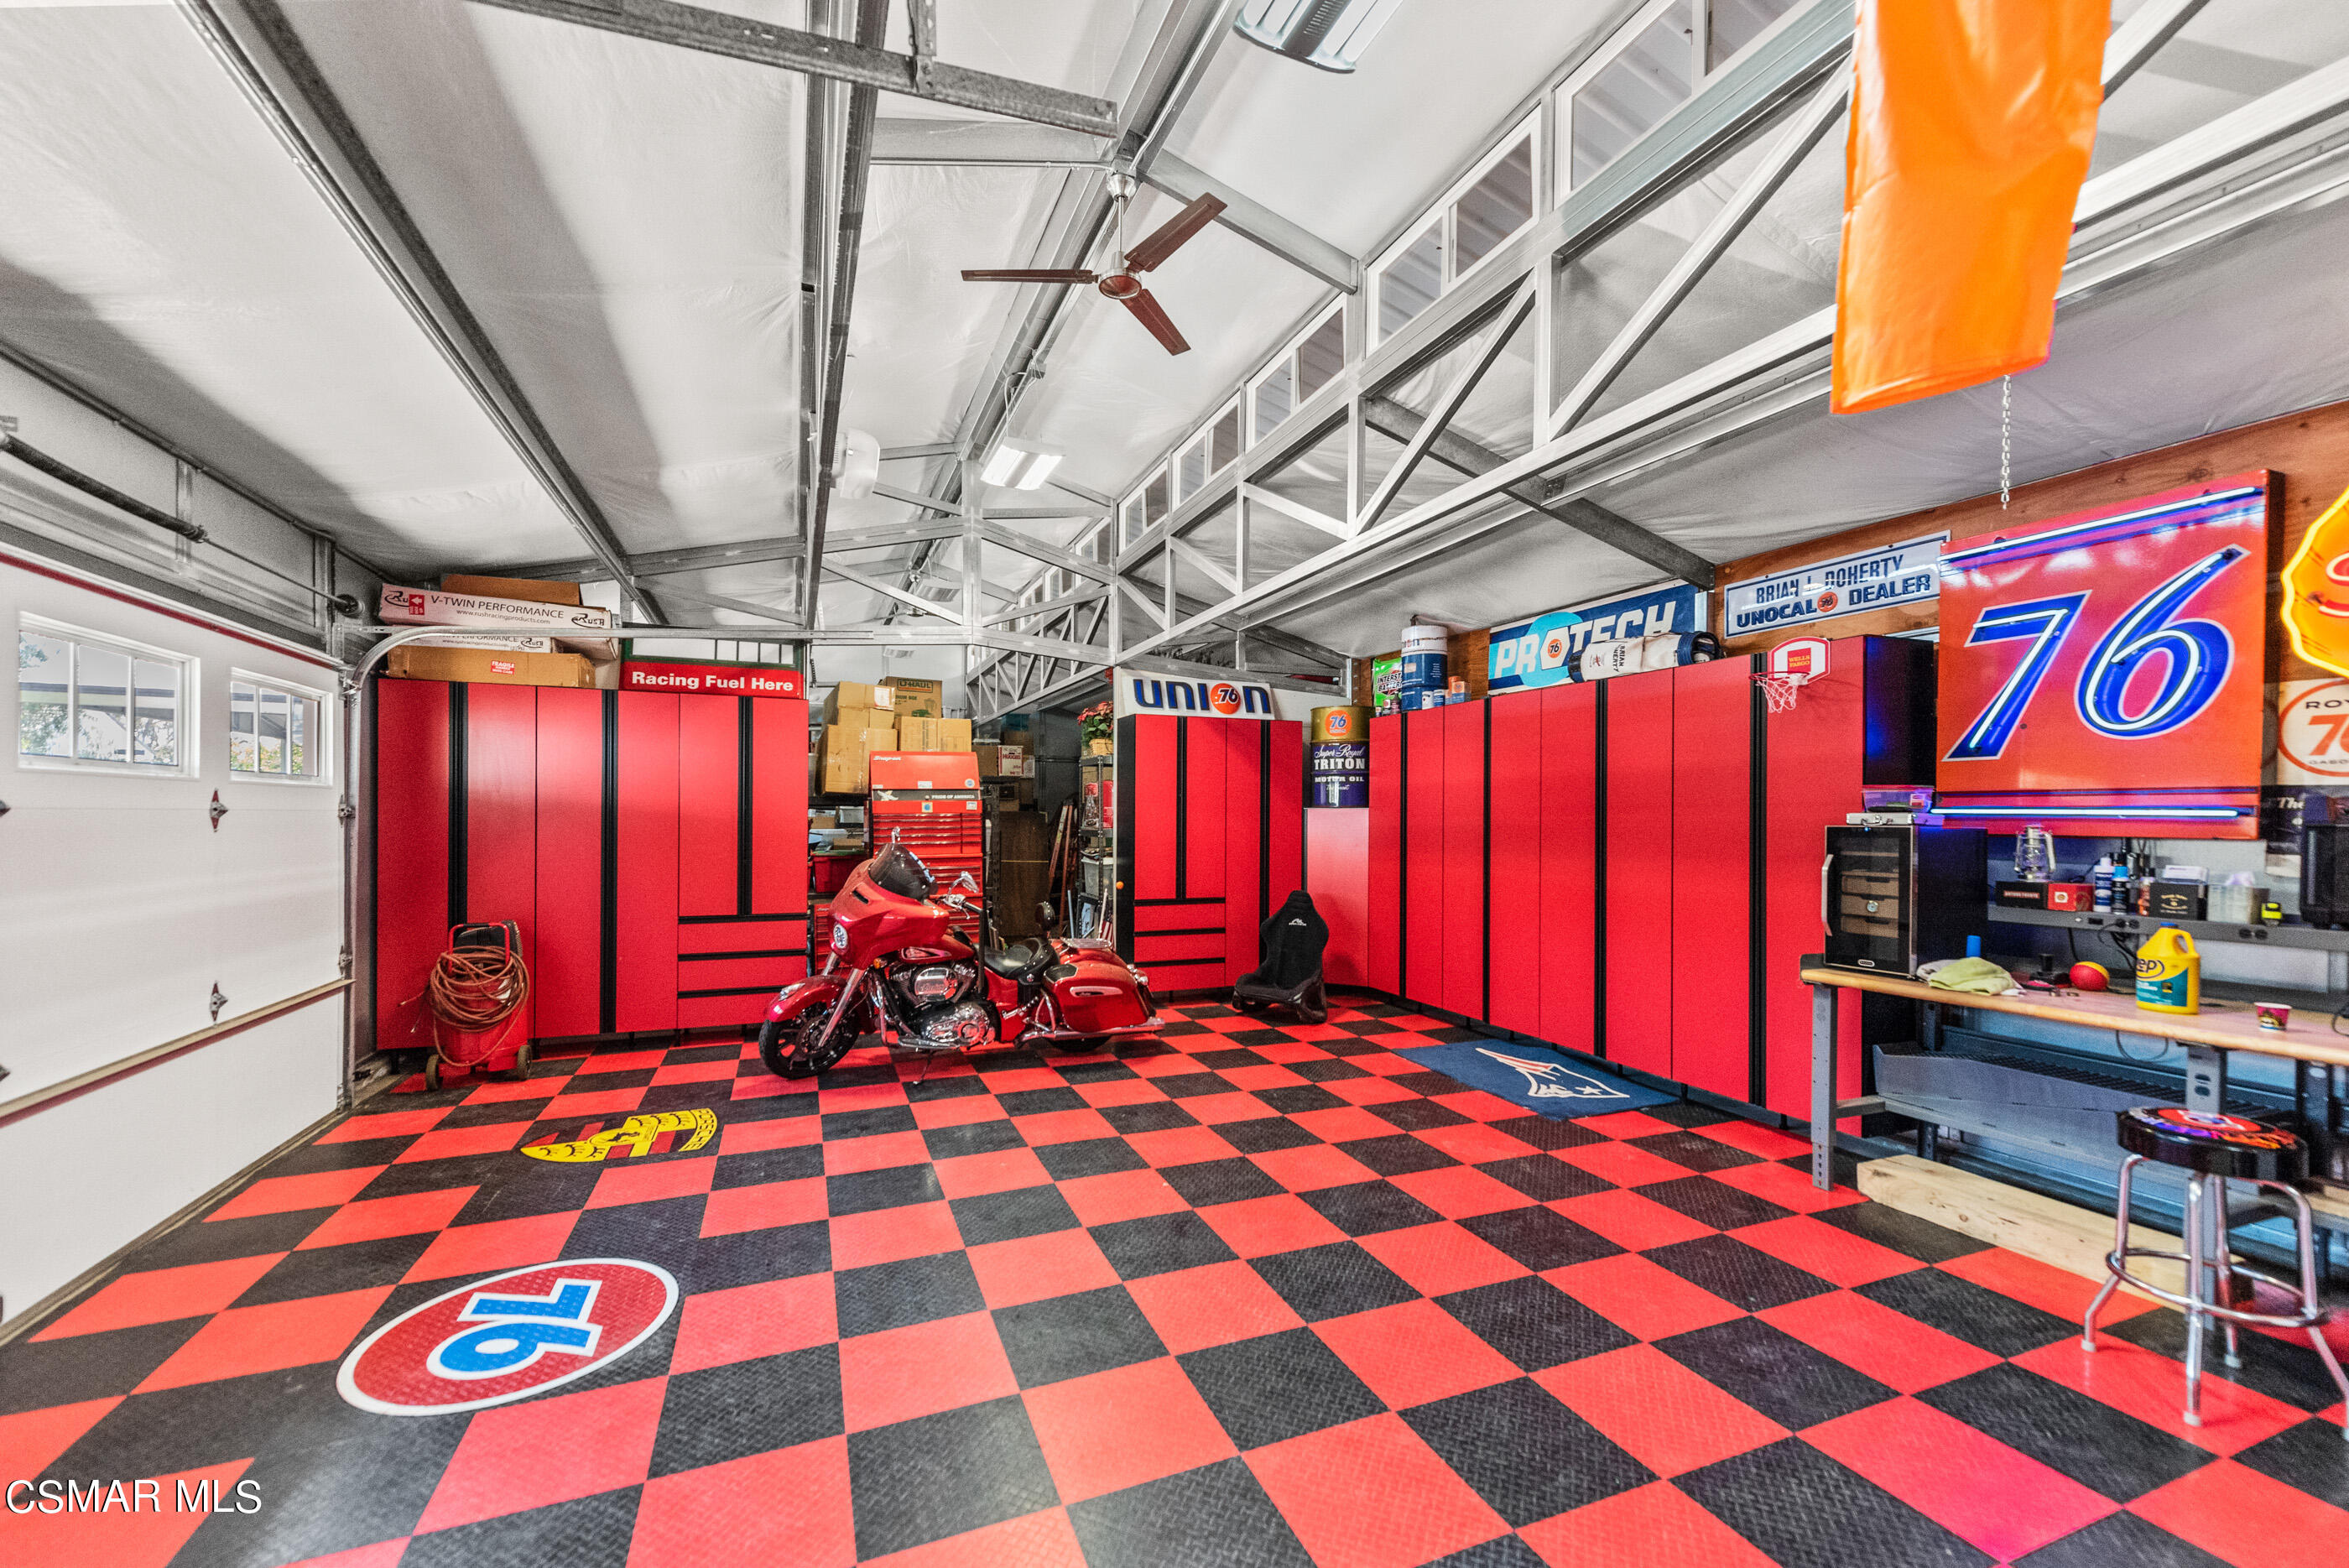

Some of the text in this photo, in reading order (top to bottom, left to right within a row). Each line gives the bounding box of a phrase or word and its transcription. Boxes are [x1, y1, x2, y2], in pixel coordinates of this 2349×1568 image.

[1757, 578, 1799, 604] BRIAN
[1825, 555, 1904, 588] DOHERTY
[431, 595, 565, 619] V-TWIN PERFORMANCE
[1737, 599, 1817, 628] UNOCAL
[1849, 574, 1931, 605] DEALER
[456, 609, 550, 624] www.rushracingproducts.com
[1550, 643, 1560, 654] 76
[1940, 544, 2251, 762] 76
[632, 672, 793, 691] Racing Fuel Here
[1218, 687, 1239, 704] 76
[1329, 714, 1347, 729] 76
[1314, 758, 1366, 770] TRITON
[426, 1277, 603, 1381] 76
